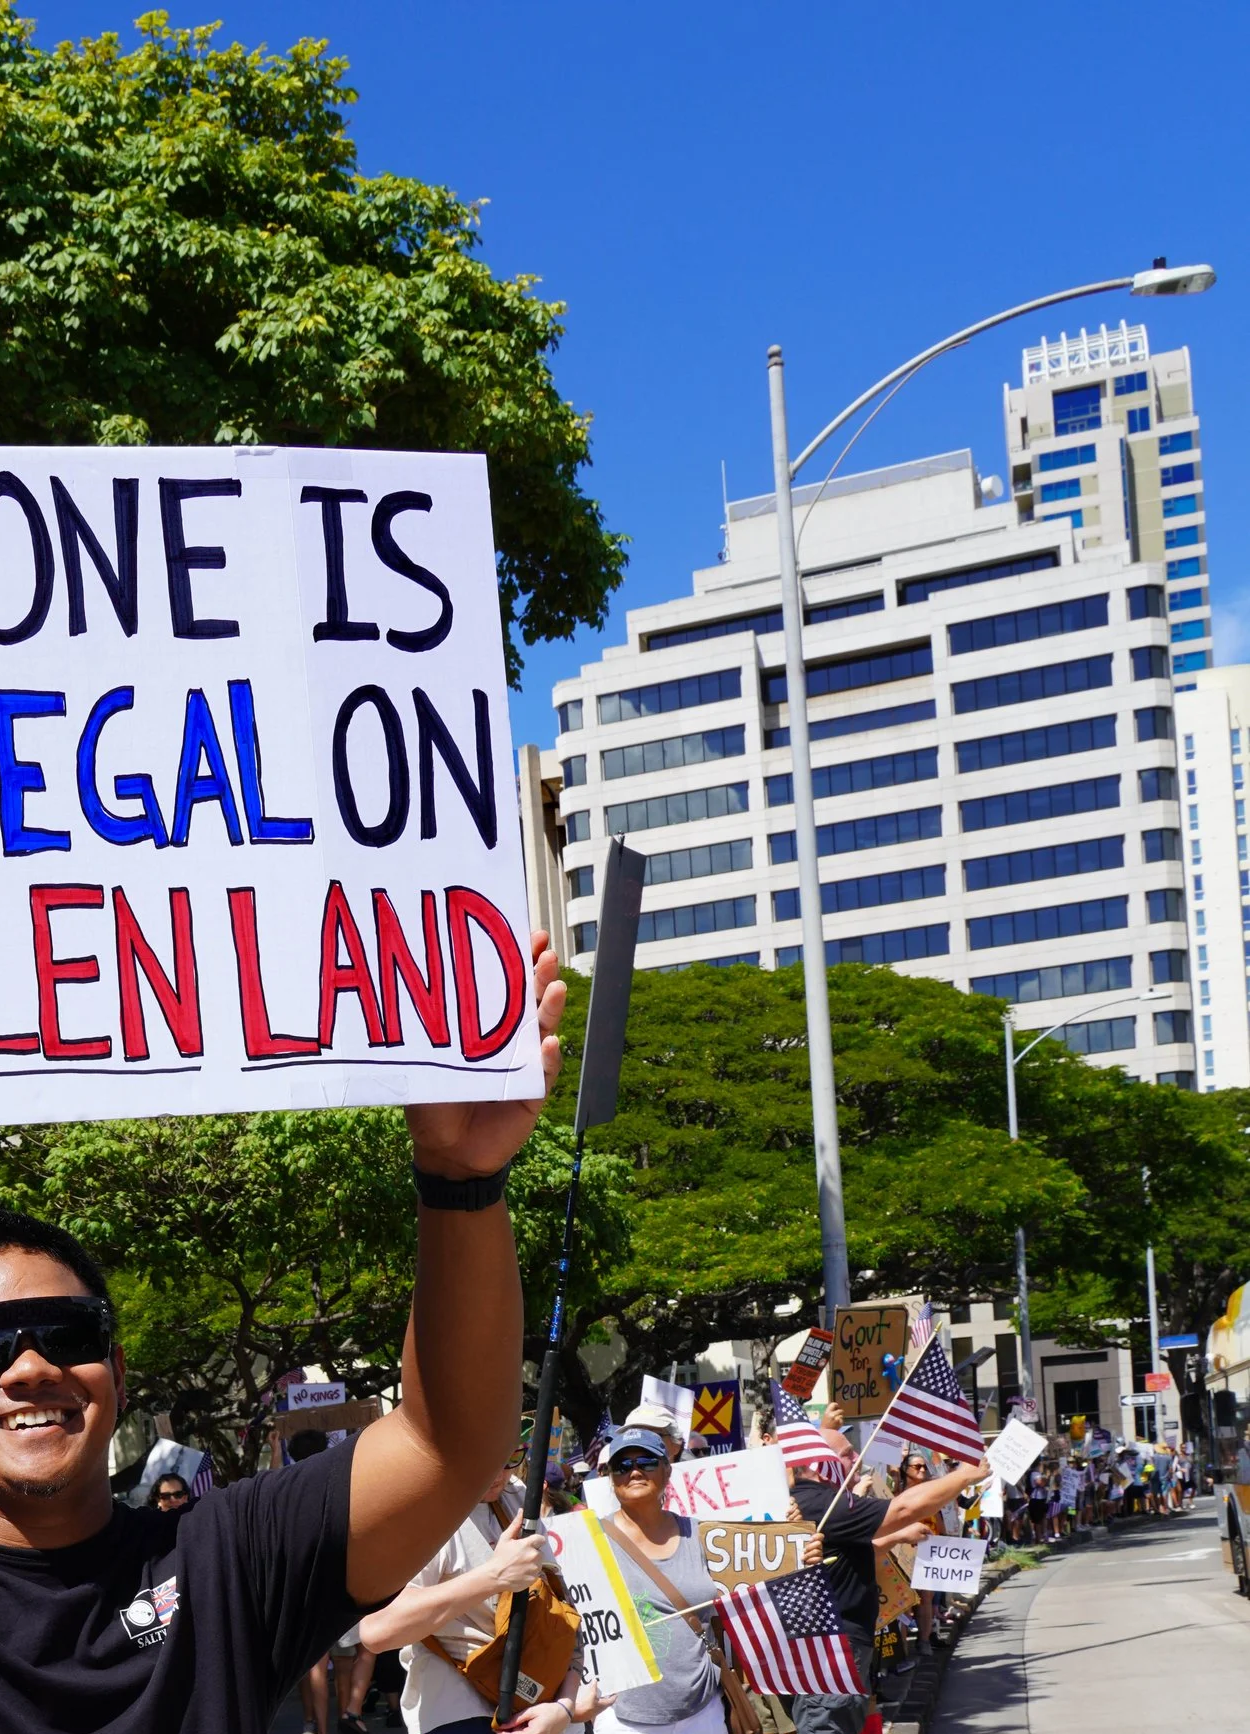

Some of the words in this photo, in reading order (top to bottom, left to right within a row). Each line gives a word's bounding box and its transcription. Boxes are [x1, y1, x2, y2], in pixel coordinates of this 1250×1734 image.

[300, 486, 453, 653] IS
[333, 684, 496, 850] ON
[227, 880, 527, 1061] LAND
[850, 1348, 870, 1373] for
[293, 1388, 308, 1405] NO
[310, 1389, 341, 1403] KINGS
[833, 1368, 880, 1415] People
[664, 1464, 750, 1517] AKE
[705, 1528, 811, 1572] SHUT
[930, 1545, 972, 1561] FUCK
[923, 1566, 974, 1582] TRUMP
